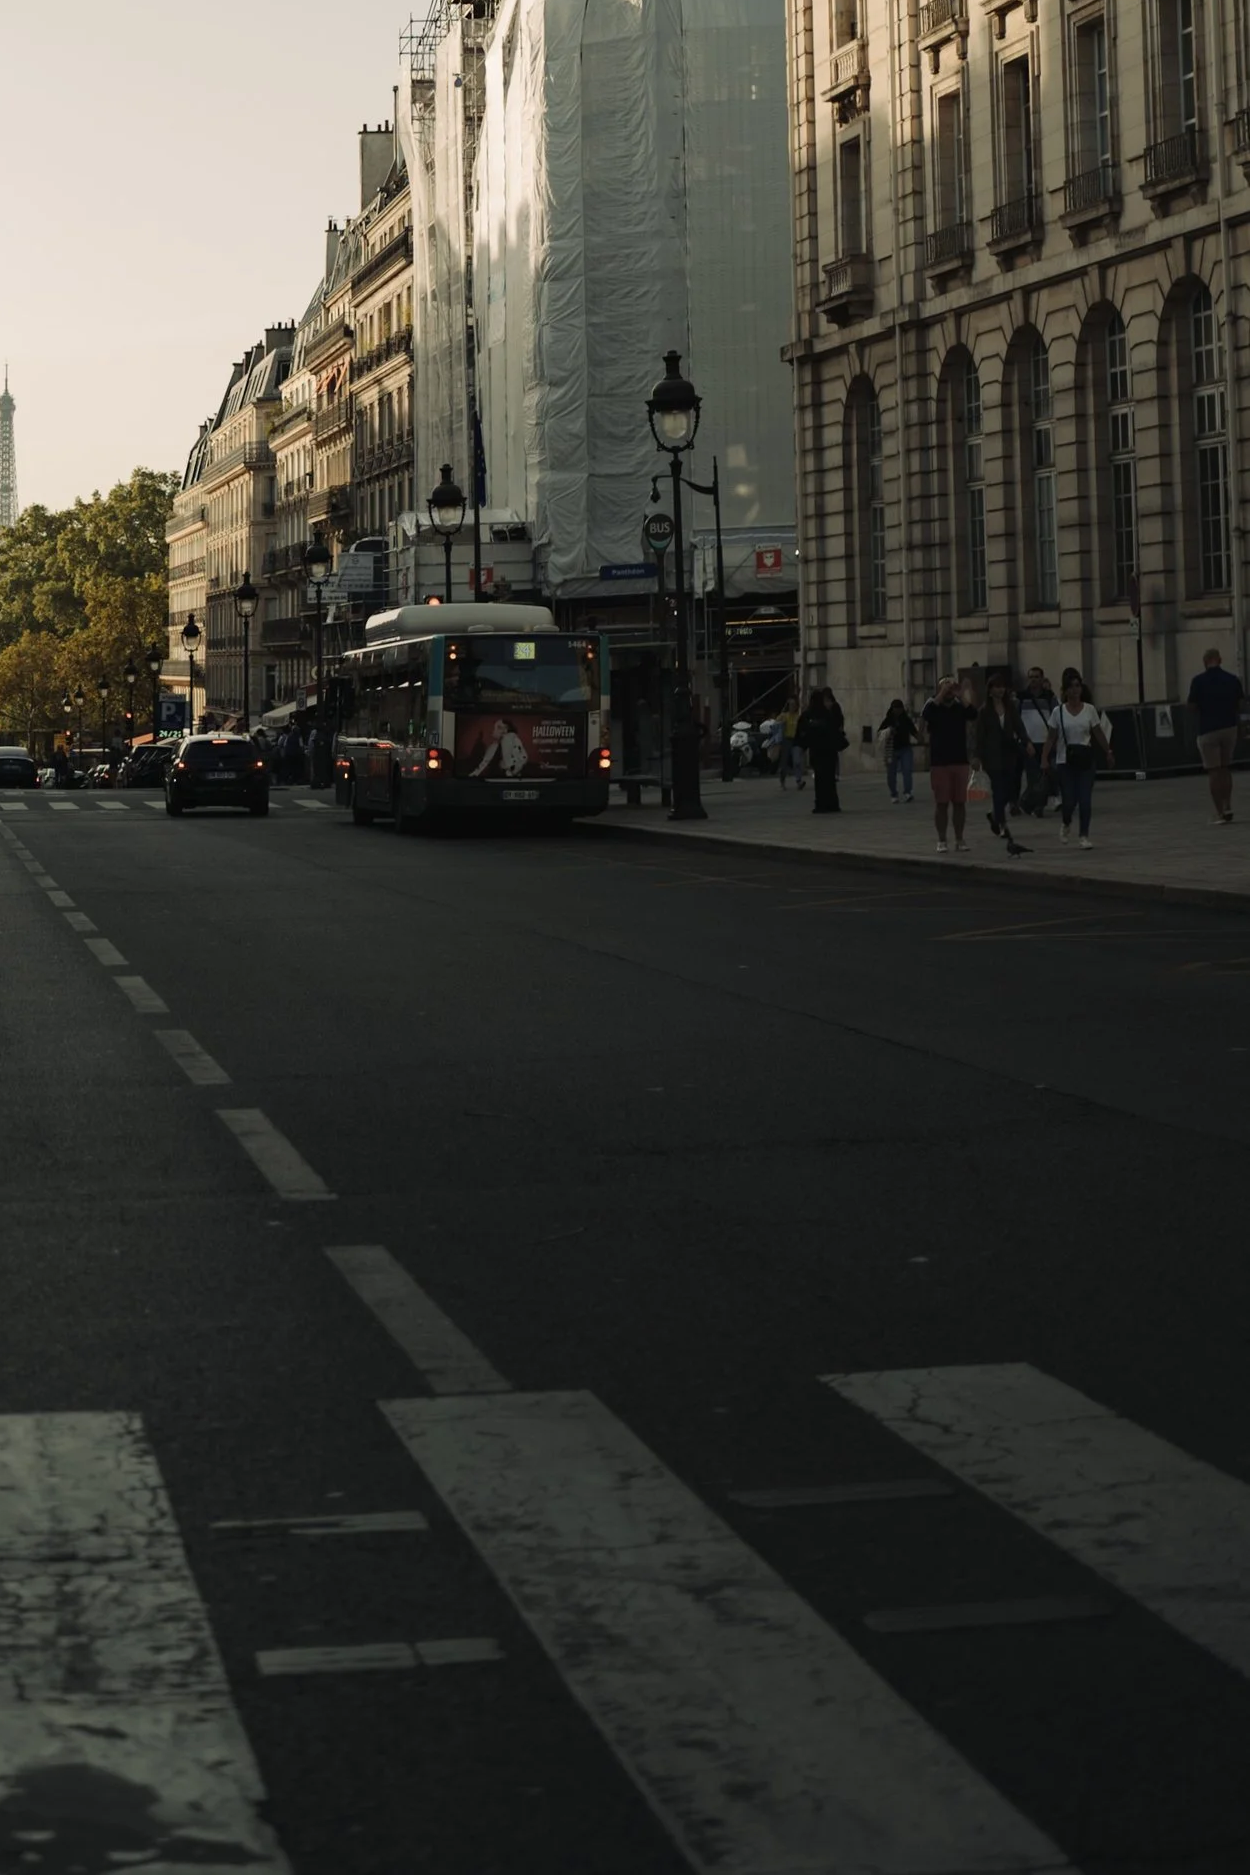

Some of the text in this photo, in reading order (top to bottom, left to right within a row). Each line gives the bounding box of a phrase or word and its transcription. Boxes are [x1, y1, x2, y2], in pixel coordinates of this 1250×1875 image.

[649, 522, 671, 534] BUS
[161, 702, 177, 722] P
[532, 725, 576, 737] HALLOWEEN
